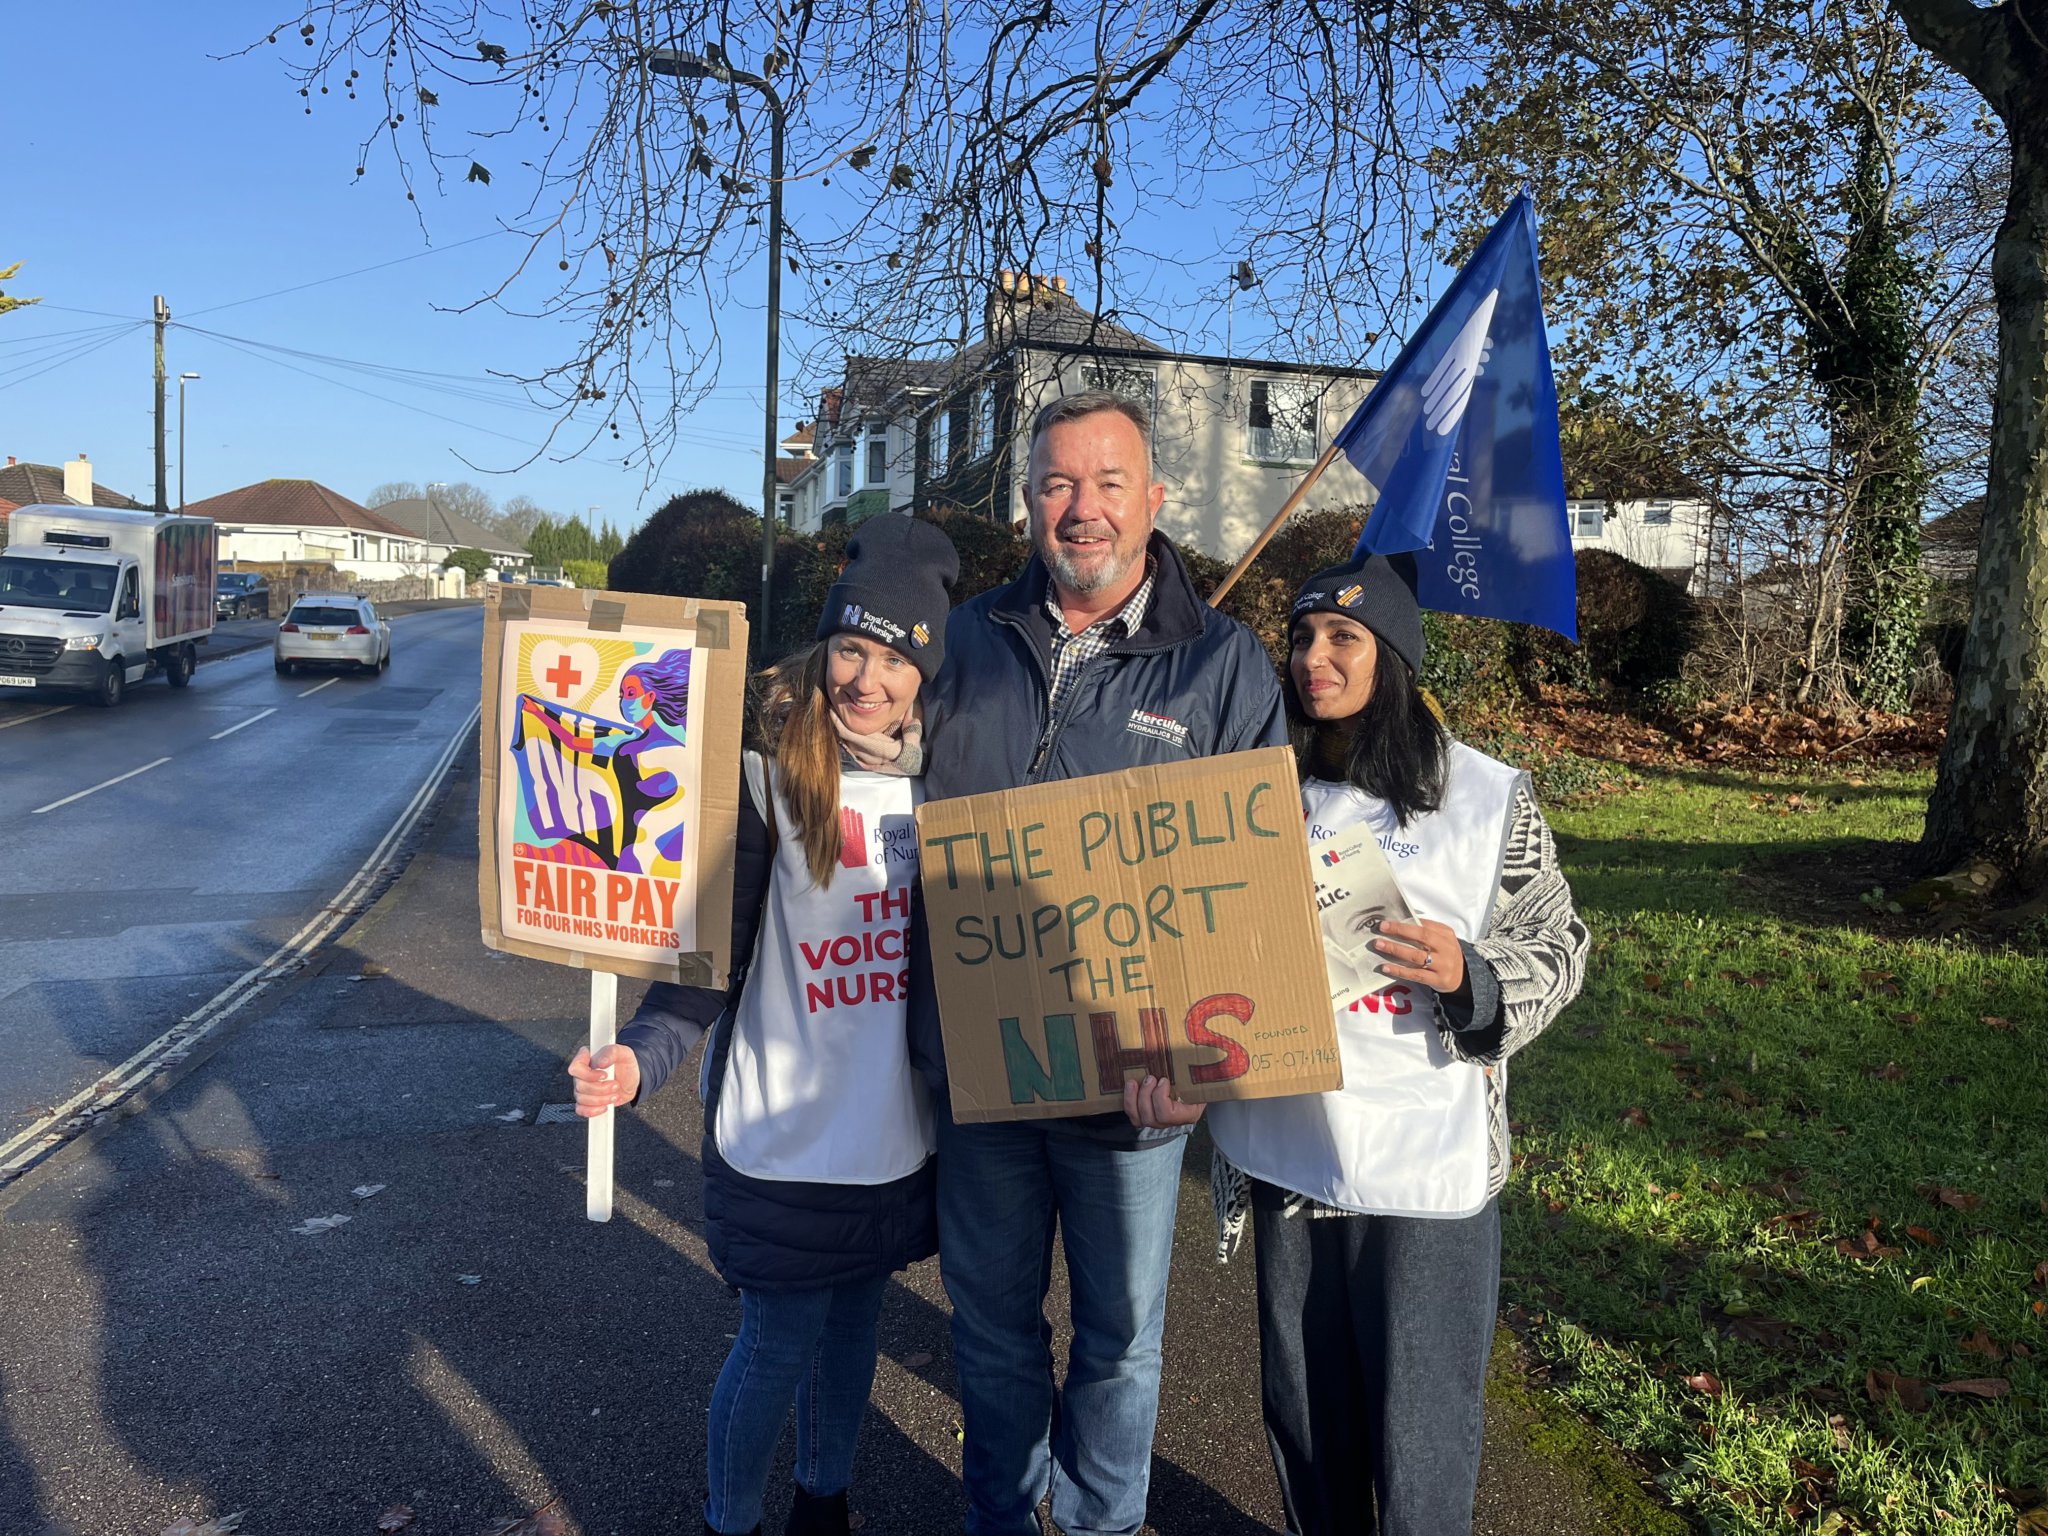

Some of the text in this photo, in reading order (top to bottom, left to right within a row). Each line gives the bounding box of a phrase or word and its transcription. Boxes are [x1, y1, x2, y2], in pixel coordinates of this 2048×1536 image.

[1447, 491, 1482, 600] College
[860, 621, 894, 643] of Nursing
[863, 611, 884, 625] Royal
[882, 619, 907, 638] College
[1128, 722, 1171, 739] HYDRAULICS
[1130, 709, 1188, 735] Hercules
[873, 823, 910, 847] Royal
[926, 782, 1280, 892] THE PUBLIC
[875, 847, 889, 865] of
[514, 860, 680, 929] FAIR PAY
[517, 908, 680, 949] FOR OUR NHS WORKERS
[954, 881, 1248, 966] SUPPORT
[1049, 955, 1154, 1002] THE
[998, 993, 1255, 1104] NHS
[1254, 1025, 1308, 1041] FOUNDED
